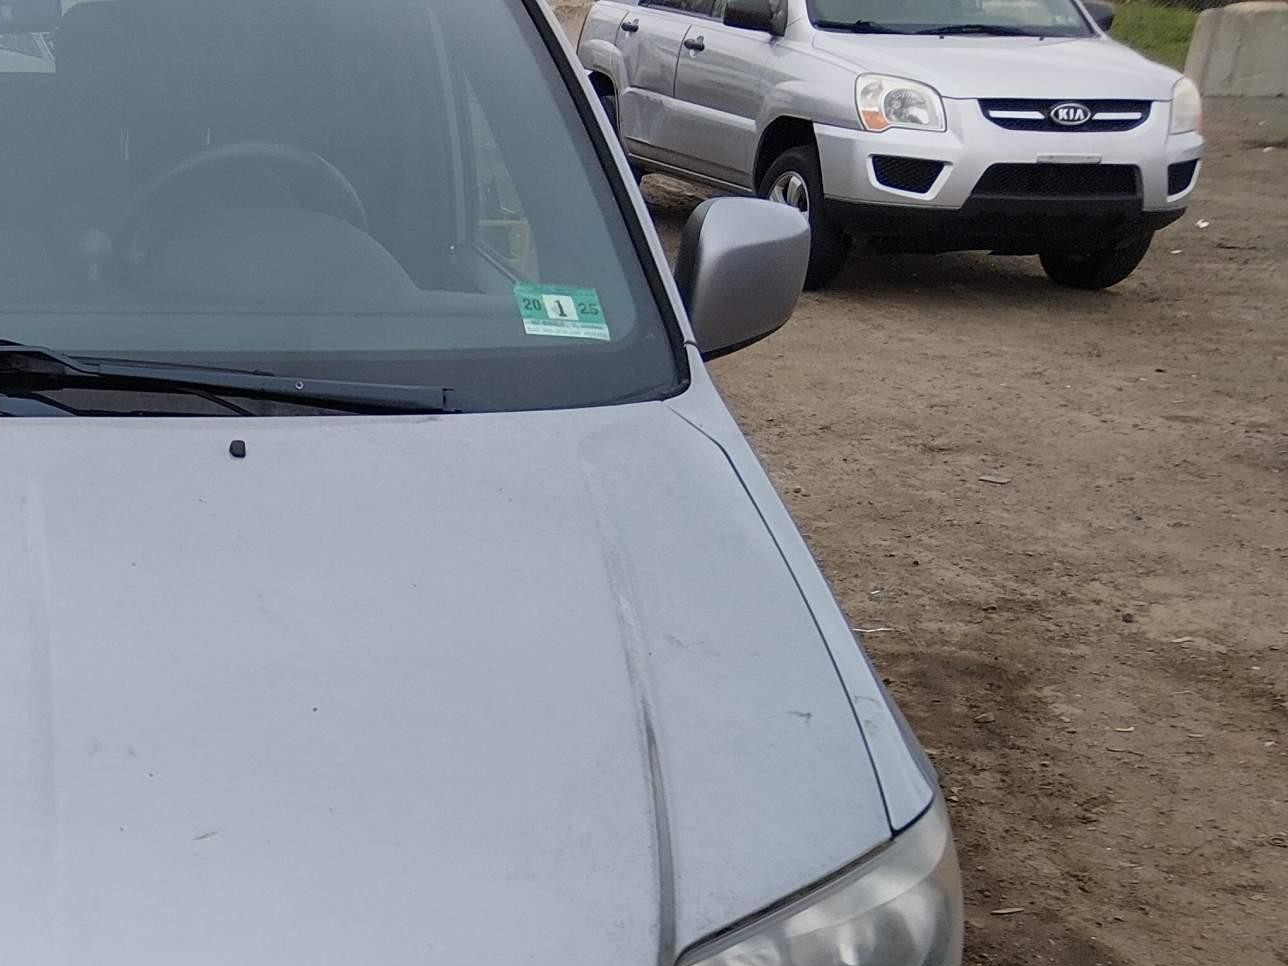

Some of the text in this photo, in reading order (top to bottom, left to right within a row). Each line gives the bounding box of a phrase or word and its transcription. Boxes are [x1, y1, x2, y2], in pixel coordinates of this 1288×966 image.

[1058, 108, 1085, 120] KIA
[522, 298, 599, 318] 20 1 25
